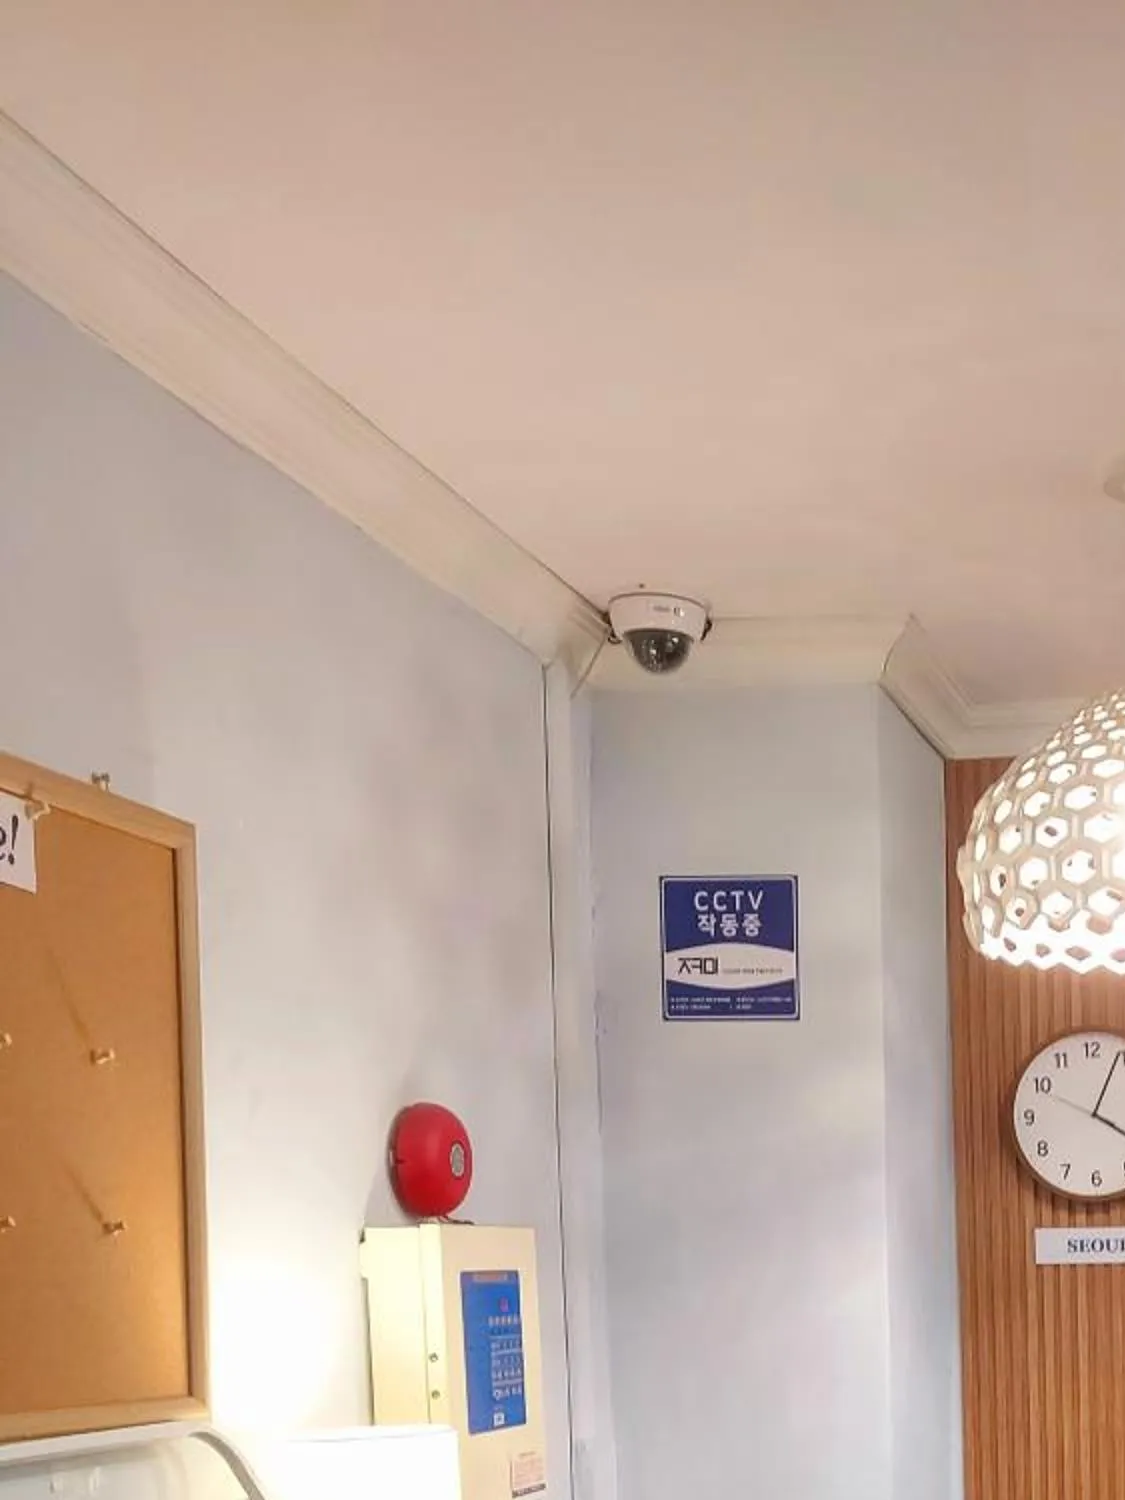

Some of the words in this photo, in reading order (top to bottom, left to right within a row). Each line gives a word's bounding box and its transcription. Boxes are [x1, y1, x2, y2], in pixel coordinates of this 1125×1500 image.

[694, 890, 763, 911] CCTV
[698, 913, 761, 937] 작동중
[1084, 1042, 1101, 1059] 12
[1054, 1052, 1068, 1068] 11
[1034, 1078, 1051, 1094] 10
[1023, 1111, 1035, 1126] 9
[1037, 1141, 1048, 1157] 8
[1060, 1164, 1071, 1180] 7
[1091, 1171, 1102, 1187] 6
